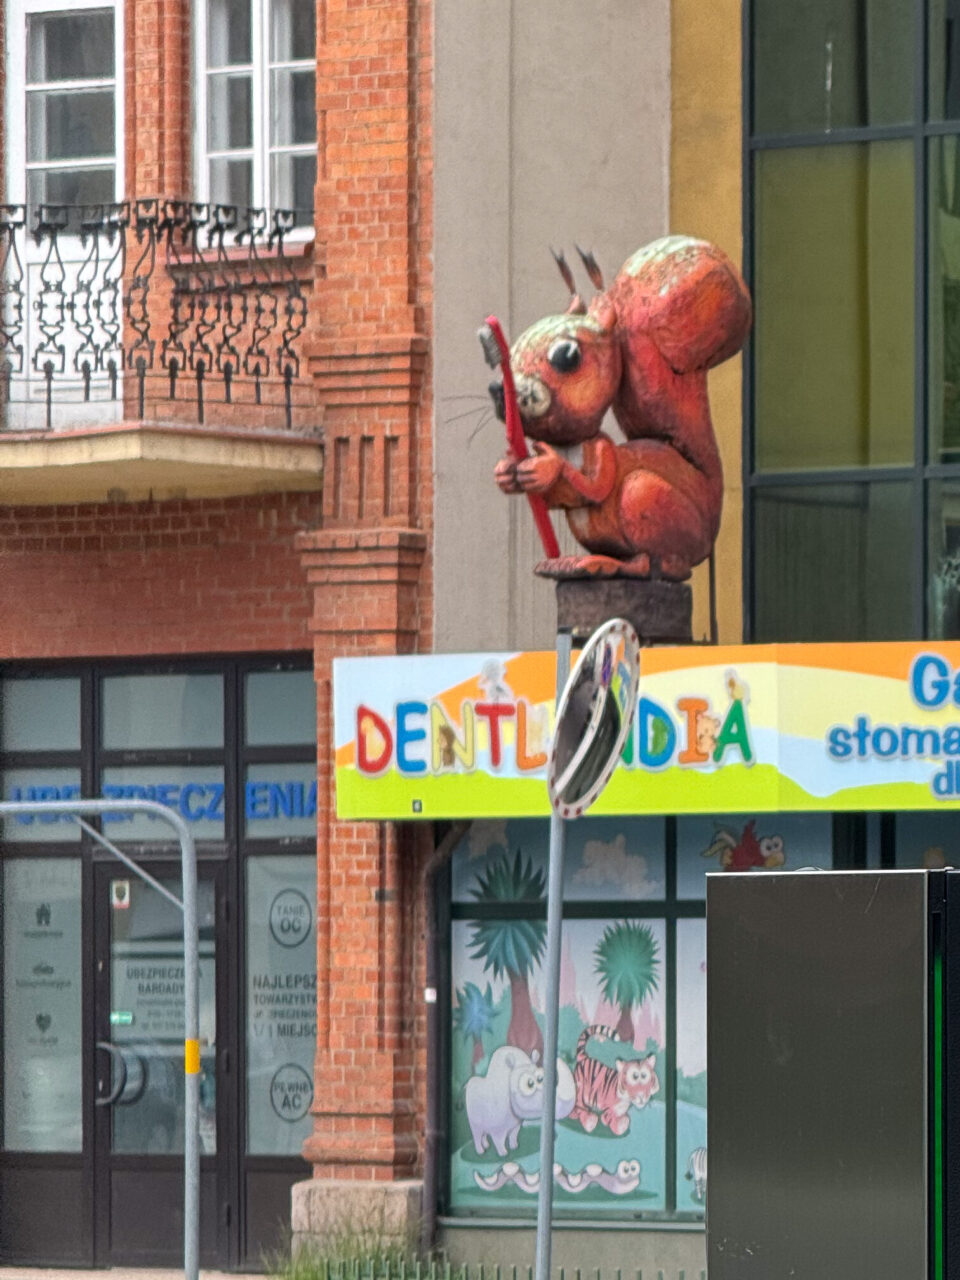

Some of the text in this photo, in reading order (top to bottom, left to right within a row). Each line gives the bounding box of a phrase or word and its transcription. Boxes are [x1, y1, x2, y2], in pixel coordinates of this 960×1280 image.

[356, 697, 752, 773] DENTLDIA
[280, 917, 302, 934] OC
[281, 1094, 302, 1111] AC
